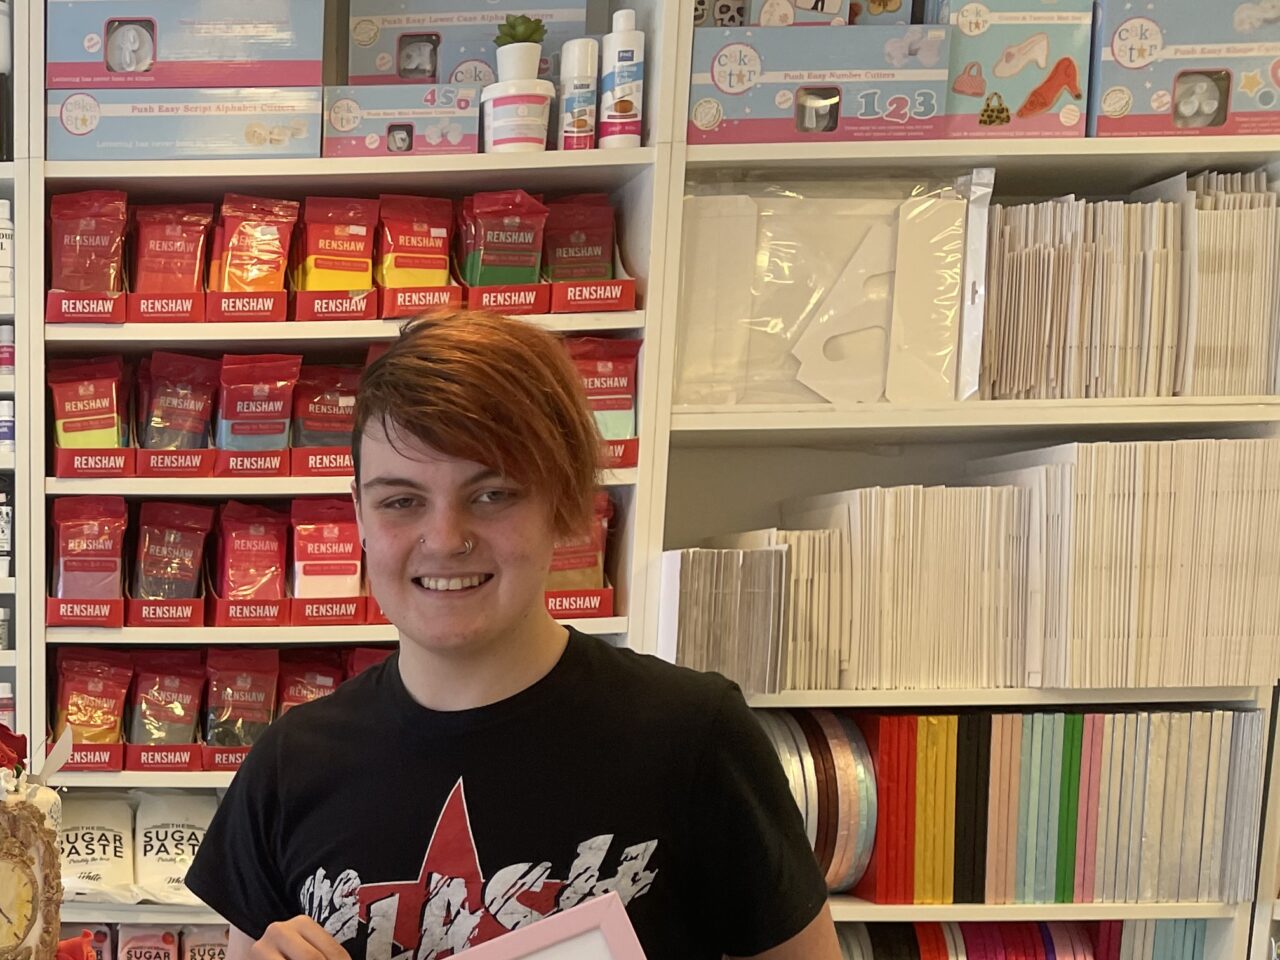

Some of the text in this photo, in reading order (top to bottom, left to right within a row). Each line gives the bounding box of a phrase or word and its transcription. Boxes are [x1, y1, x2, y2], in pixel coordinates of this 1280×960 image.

[382, 18, 403, 26] Push
[405, 17, 426, 25] Easy
[783, 72, 805, 80] Push
[807, 72, 827, 81] Easy
[828, 71, 862, 79] Number
[423, 87, 456, 107] 4 5
[131, 104, 155, 114] Push
[158, 104, 180, 114] Easy
[183, 103, 212, 114] Script
[857, 89, 937, 123] 1 2 3
[64, 234, 111, 246] RENSHAW
[399, 235, 444, 248] RENSHAW
[487, 231, 535, 244] RENSHAW
[149, 240, 196, 252] RENSHAW
[319, 239, 365, 251] RENSHAW
[556, 245, 602, 257] RENSHAW
[397, 292, 451, 306] RENSHAW
[482, 291, 537, 306] RENSHAW
[567, 285, 622, 300] RENSHAW
[61, 299, 114, 313] RENSHAW
[140, 299, 193, 313] RENSHAW
[221, 298, 275, 311] RENSHAW
[314, 299, 367, 313] RENSHAW
[65, 397, 111, 412] RENSHAW
[159, 396, 205, 412] RENSHAW
[236, 400, 283, 413] RENSHAW
[308, 403, 354, 416] RENSHAW
[74, 455, 125, 469] RENSHAW
[150, 454, 202, 468] RENSHAW
[229, 456, 281, 470] RENSHAW
[308, 454, 355, 468] RENSHA
[68, 538, 113, 551] RENSHAW
[148, 544, 194, 559] RENSHAW
[234, 539, 279, 551] RENSHAW
[307, 542, 354, 555] RENSHAW
[60, 603, 111, 617] RENSHAW
[305, 603, 357, 617] RENSHAW
[548, 596, 601, 610] RENSHAW
[142, 605, 193, 619] RENSHAW
[229, 605, 280, 618] RENSHAW
[222, 690, 266, 702] RENSHAW
[68, 751, 110, 764] ENSHAW
[140, 751, 191, 764] RENSHAW
[144, 830, 206, 844] SUGA
[61, 843, 124, 858] ASTE
[143, 843, 199, 857] PAST
[126, 950, 171, 960] SUGAR
[190, 948, 226, 958] SUGA
